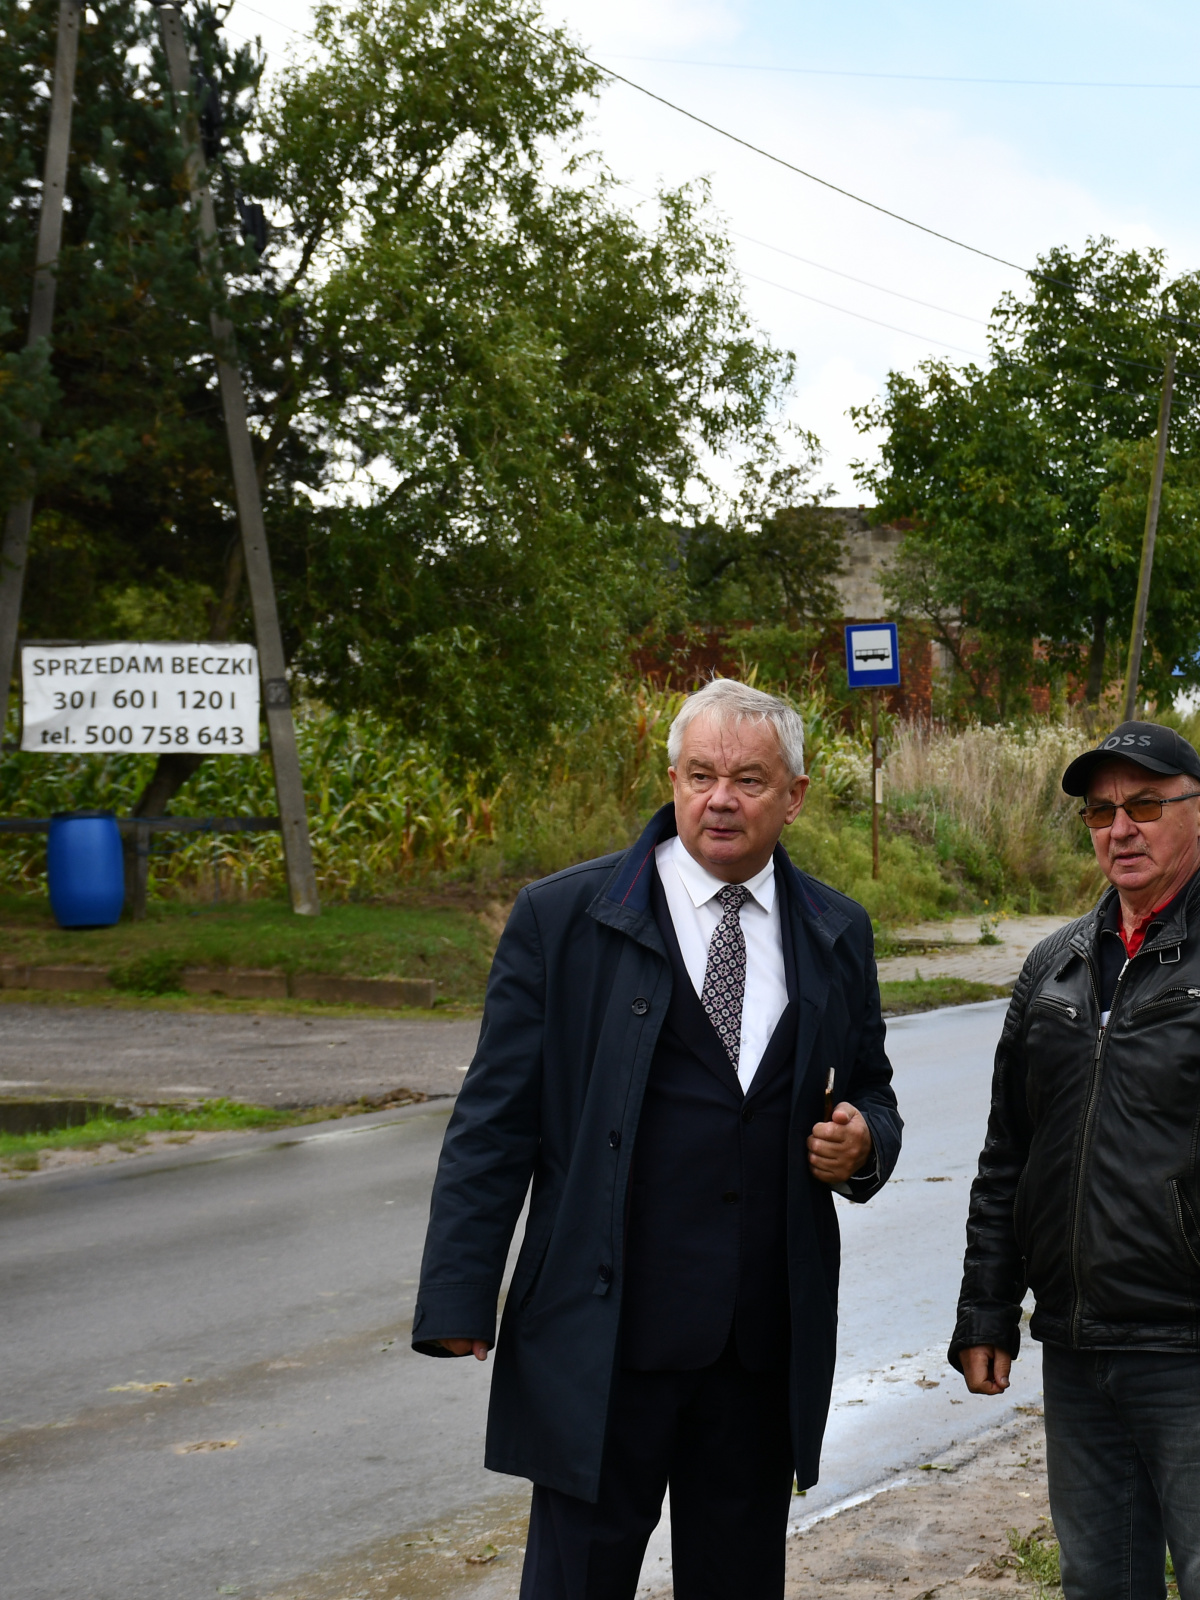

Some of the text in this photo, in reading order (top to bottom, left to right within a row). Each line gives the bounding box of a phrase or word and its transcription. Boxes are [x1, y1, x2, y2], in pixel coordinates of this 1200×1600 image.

[32, 655, 253, 677] SPRZEDAM BECZKI
[112, 689, 145, 709] 60
[177, 690, 223, 710] 120
[40, 725, 244, 746] tel. 500 758 643
[1099, 733, 1152, 750] OSS
